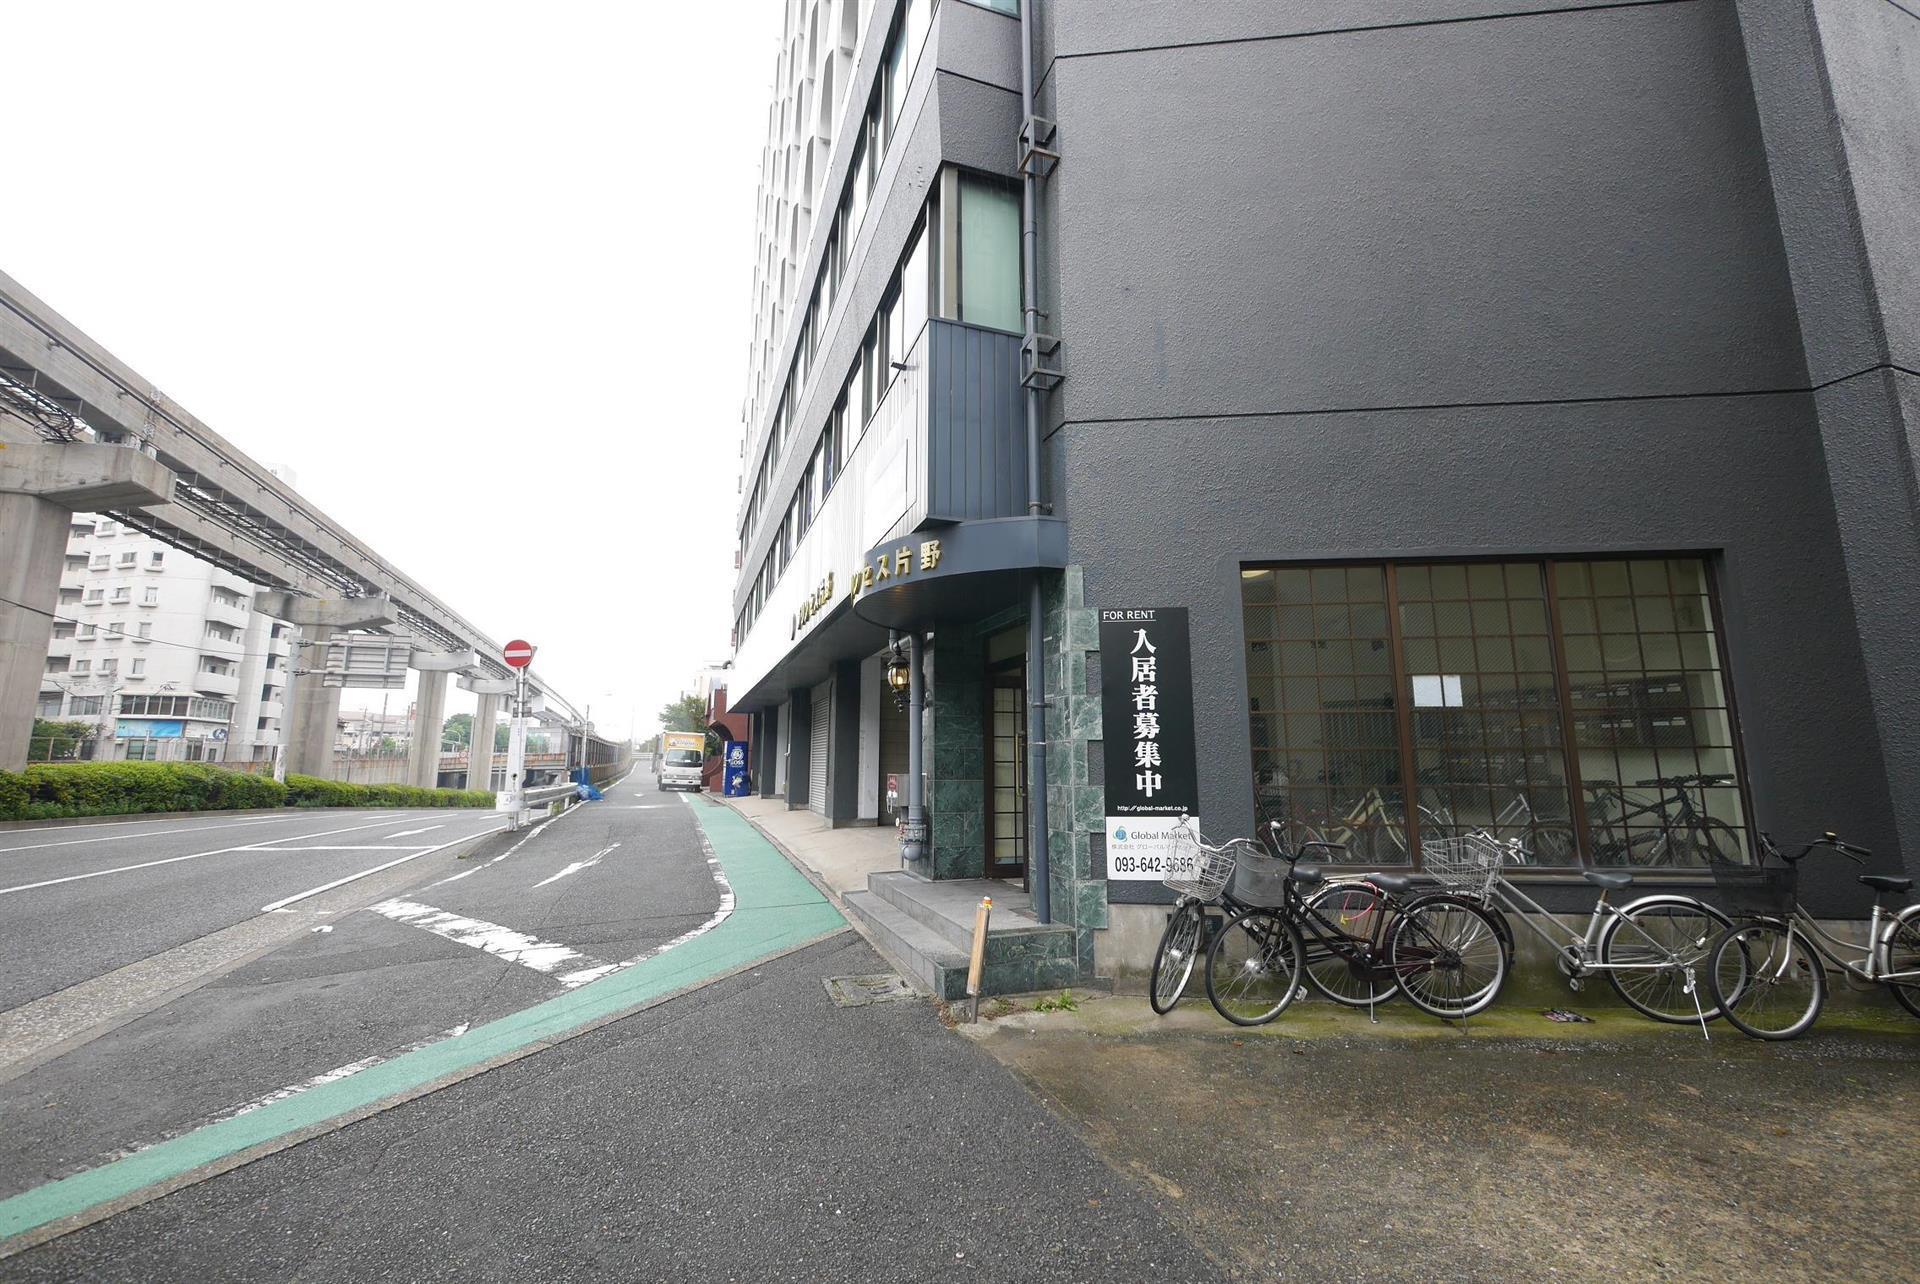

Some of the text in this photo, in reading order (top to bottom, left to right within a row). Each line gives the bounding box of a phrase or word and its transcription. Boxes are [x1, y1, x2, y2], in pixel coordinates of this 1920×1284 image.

[1103, 610, 1156, 620] FOR RENT
[1130, 628, 1162, 798] 入居者募集中
[1131, 831, 1192, 840] Global Market
[1115, 857, 1194, 873] 093-642-9686
